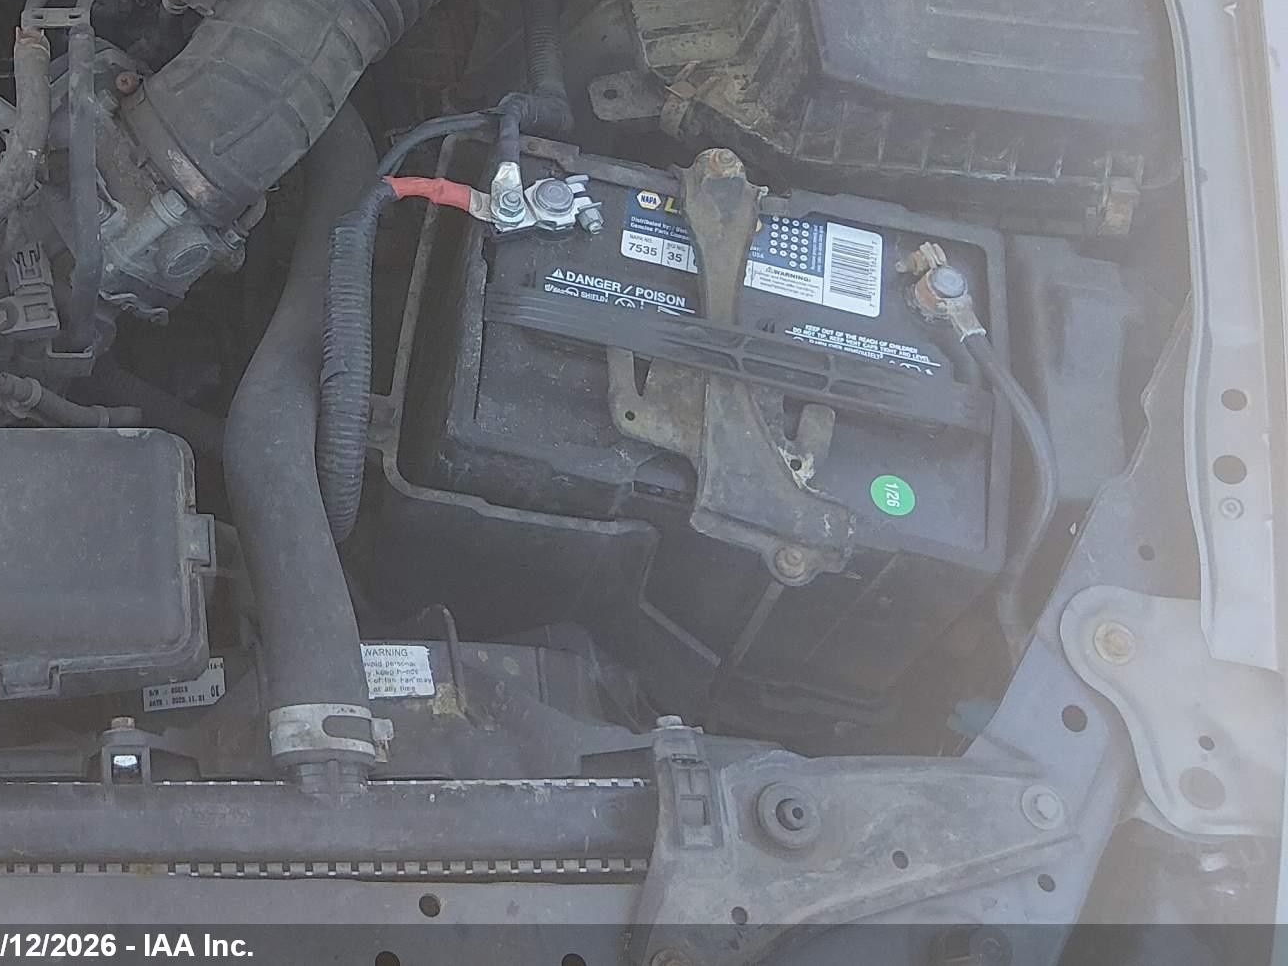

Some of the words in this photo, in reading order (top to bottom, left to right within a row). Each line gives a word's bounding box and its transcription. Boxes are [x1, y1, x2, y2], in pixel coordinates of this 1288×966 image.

[641, 195, 657, 204] NAPA
[628, 242, 657, 256] 7535
[667, 251, 682, 263] 35
[566, 271, 621, 293] DANGER
[623, 285, 633, 294] /
[635, 286, 685, 307] POISON
[805, 324, 820, 332] KEEP
[884, 483, 900, 507] 1/26
